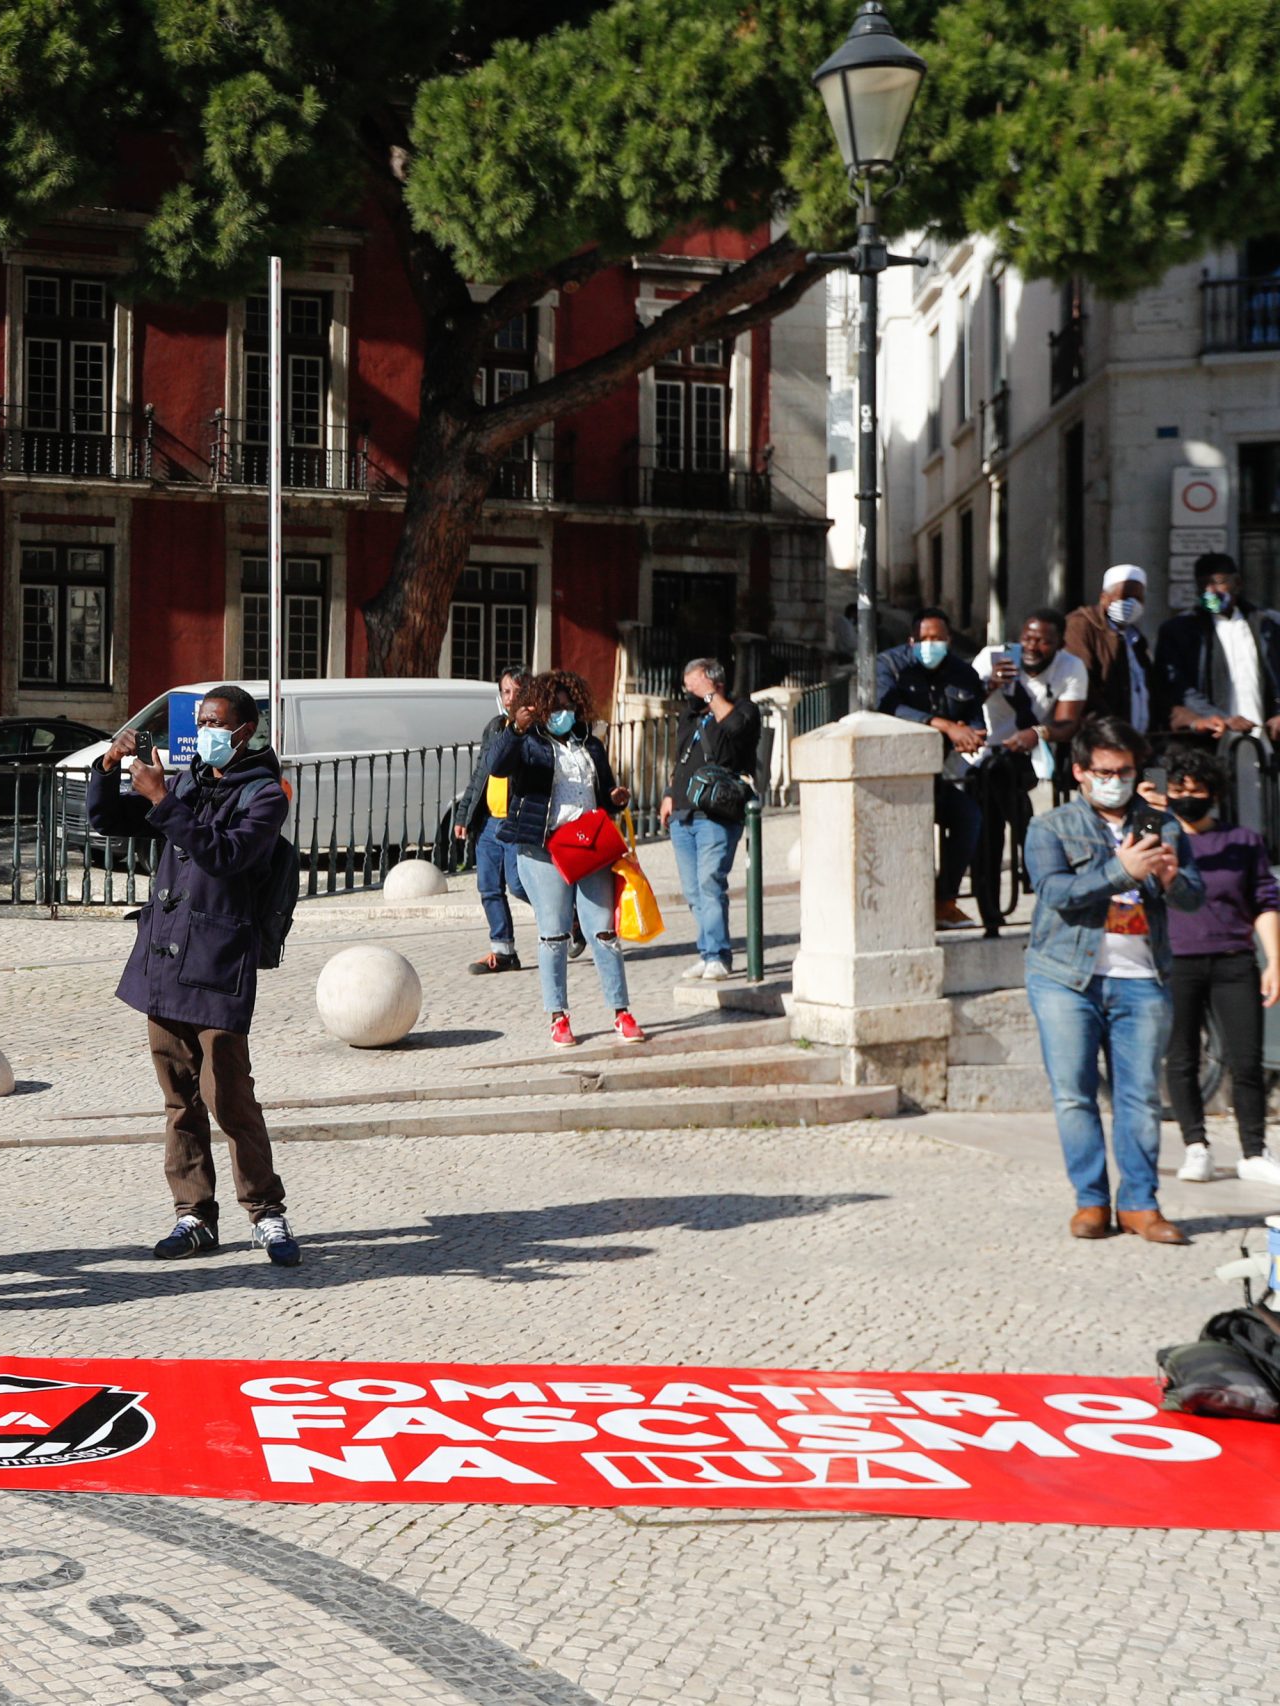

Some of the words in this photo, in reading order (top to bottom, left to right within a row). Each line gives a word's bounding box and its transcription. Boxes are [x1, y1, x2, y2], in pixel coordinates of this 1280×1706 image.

[240, 1377, 1020, 1417] COMBATER
[1044, 1393, 1158, 1420] O
[251, 1405, 1222, 1462] FASCISMO
[262, 1444, 558, 1485] NA
[581, 1450, 972, 1489] RUA
